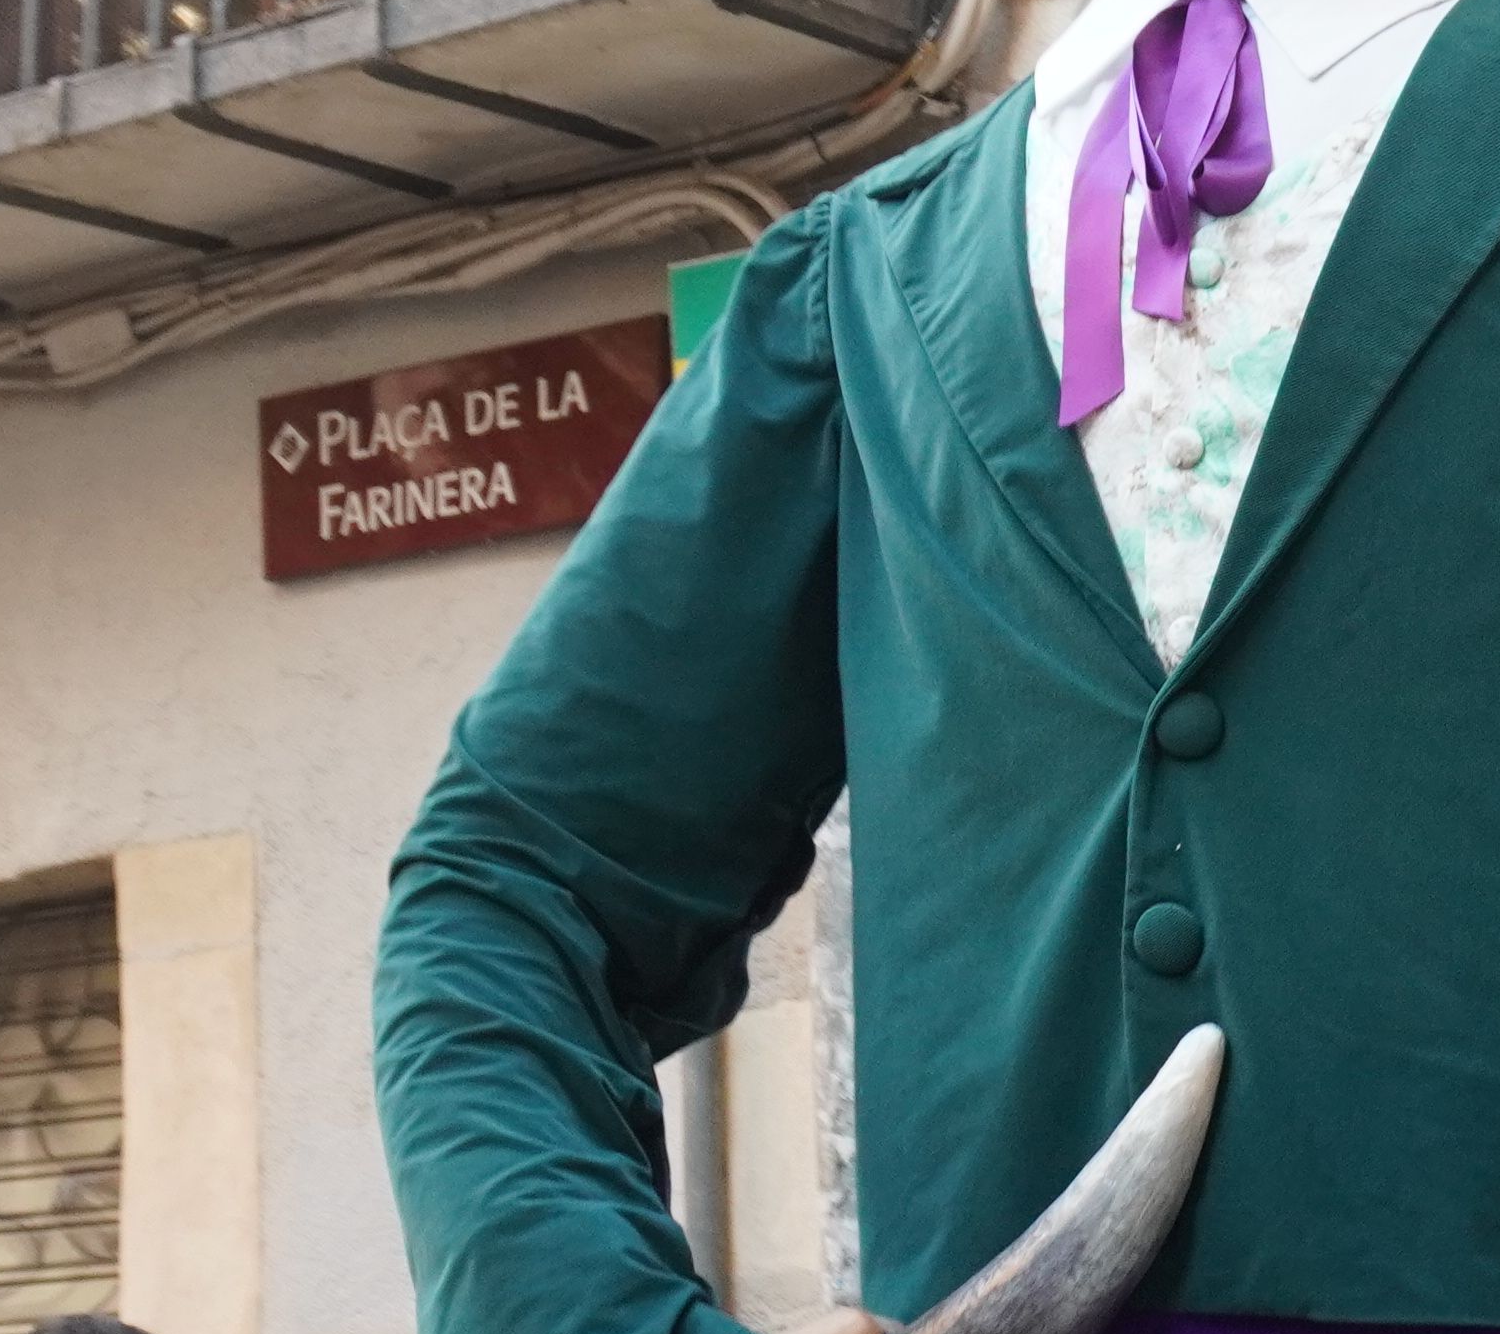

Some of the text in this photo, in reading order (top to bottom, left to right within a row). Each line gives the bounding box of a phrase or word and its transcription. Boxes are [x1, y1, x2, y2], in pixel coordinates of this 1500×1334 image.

[316, 369, 591, 465] PLAÇA DE LA
[317, 461, 518, 540] FARINERA
